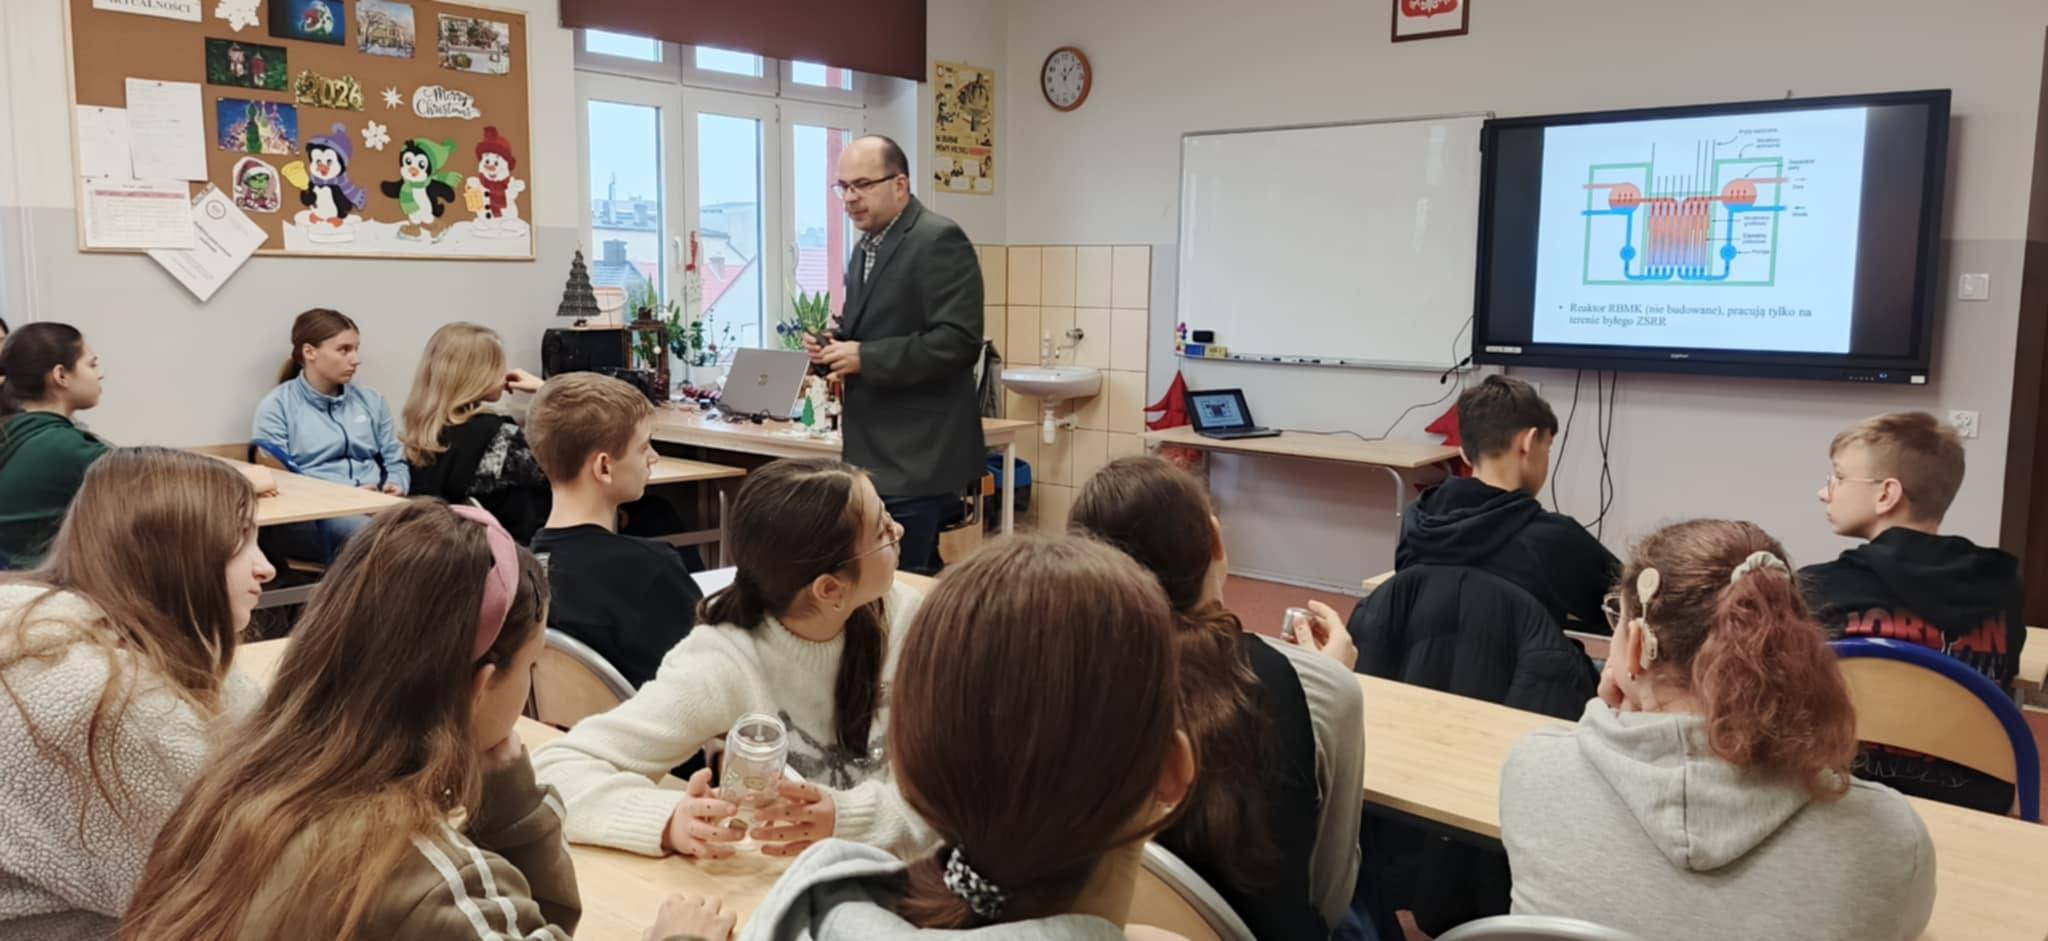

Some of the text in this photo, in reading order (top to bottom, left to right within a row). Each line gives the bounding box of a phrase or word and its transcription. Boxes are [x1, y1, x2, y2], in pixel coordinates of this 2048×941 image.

[300, 75, 363, 108] 2026
[423, 87, 468, 107] Merry
[1570, 303, 1606, 313] Reaktor
[1608, 303, 1642, 313] RBMK
[1645, 303, 1664, 314] (nie
[1727, 306, 1766, 318] pracują
[1768, 306, 1796, 319] tylko
[1798, 308, 1812, 317] na
[1569, 316, 1600, 325] terenie
[1636, 316, 1667, 327] ZSRR
